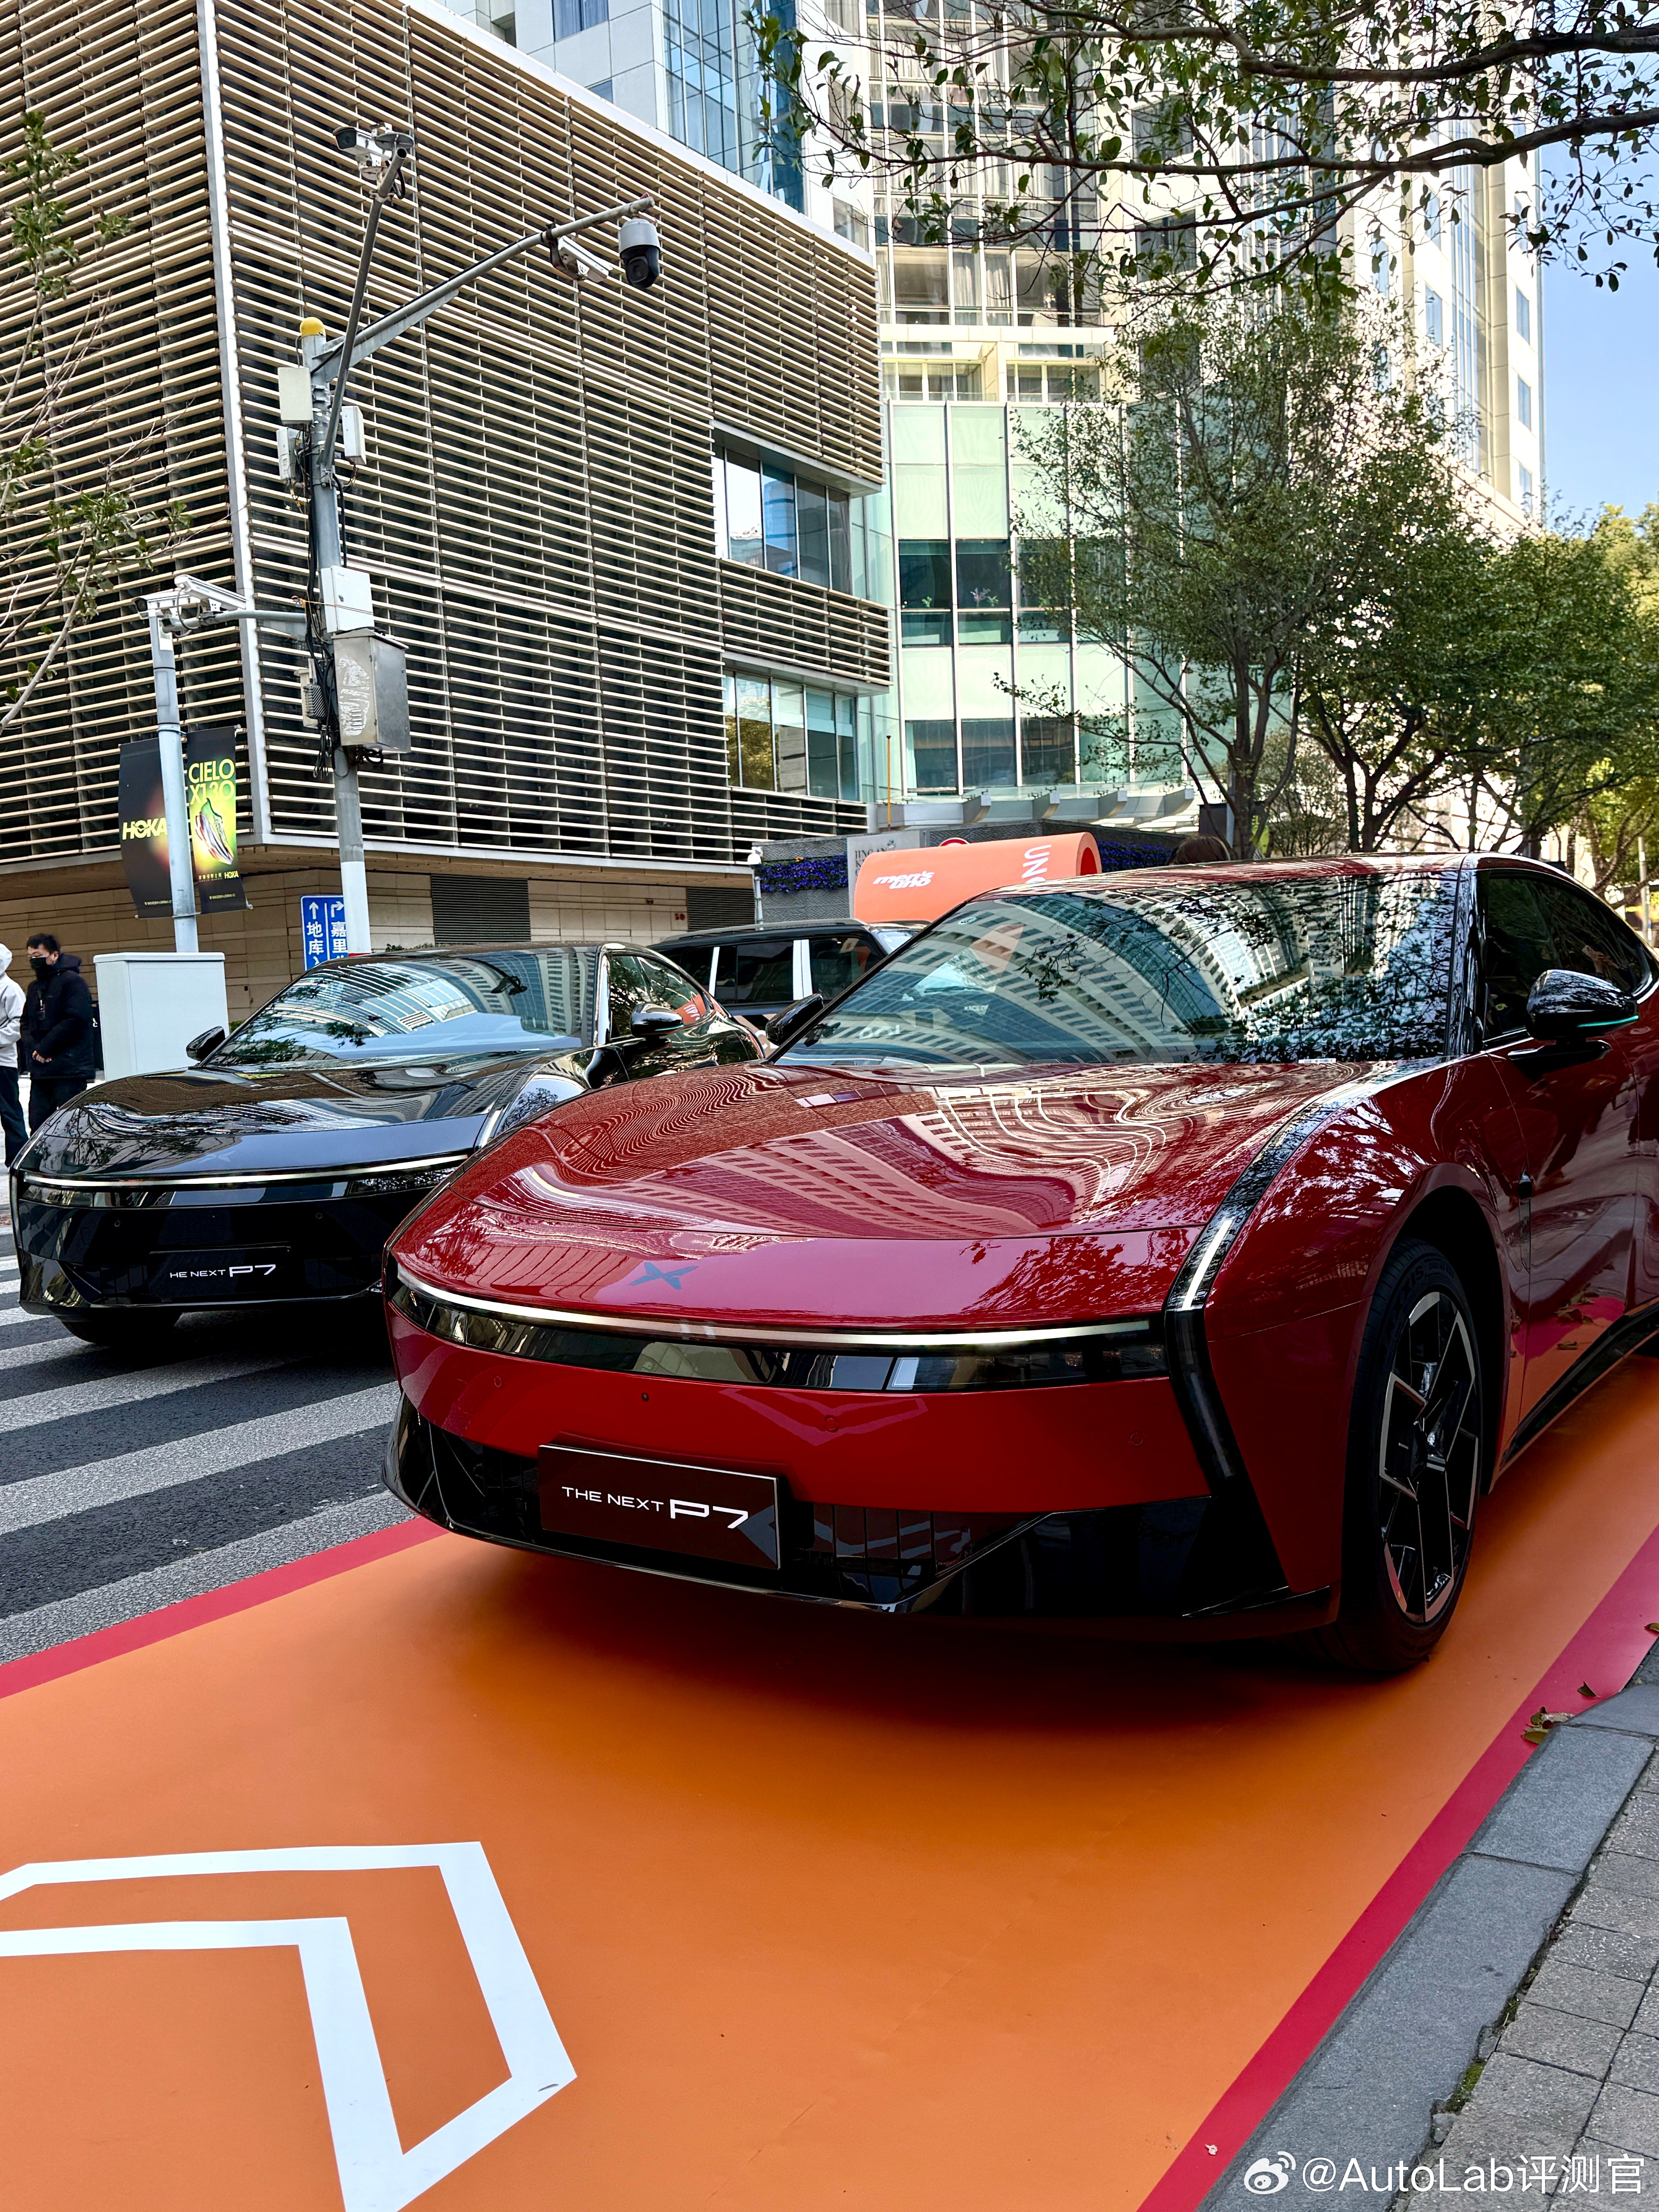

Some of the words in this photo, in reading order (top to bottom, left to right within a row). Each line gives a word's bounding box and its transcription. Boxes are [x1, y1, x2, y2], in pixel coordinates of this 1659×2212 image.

[189, 758, 235, 783] CIELO
[122, 817, 167, 840] HOKA
[224, 871, 239, 879] HOKA
[873, 871, 934, 884] men's
[889, 878, 931, 889] uno
[331, 921, 348, 959] 嘉里
[229, 1264, 276, 1277] P7
[562, 1486, 602, 1502] THE
[608, 1494, 664, 1511] NEXT
[670, 1499, 748, 1529] P7
